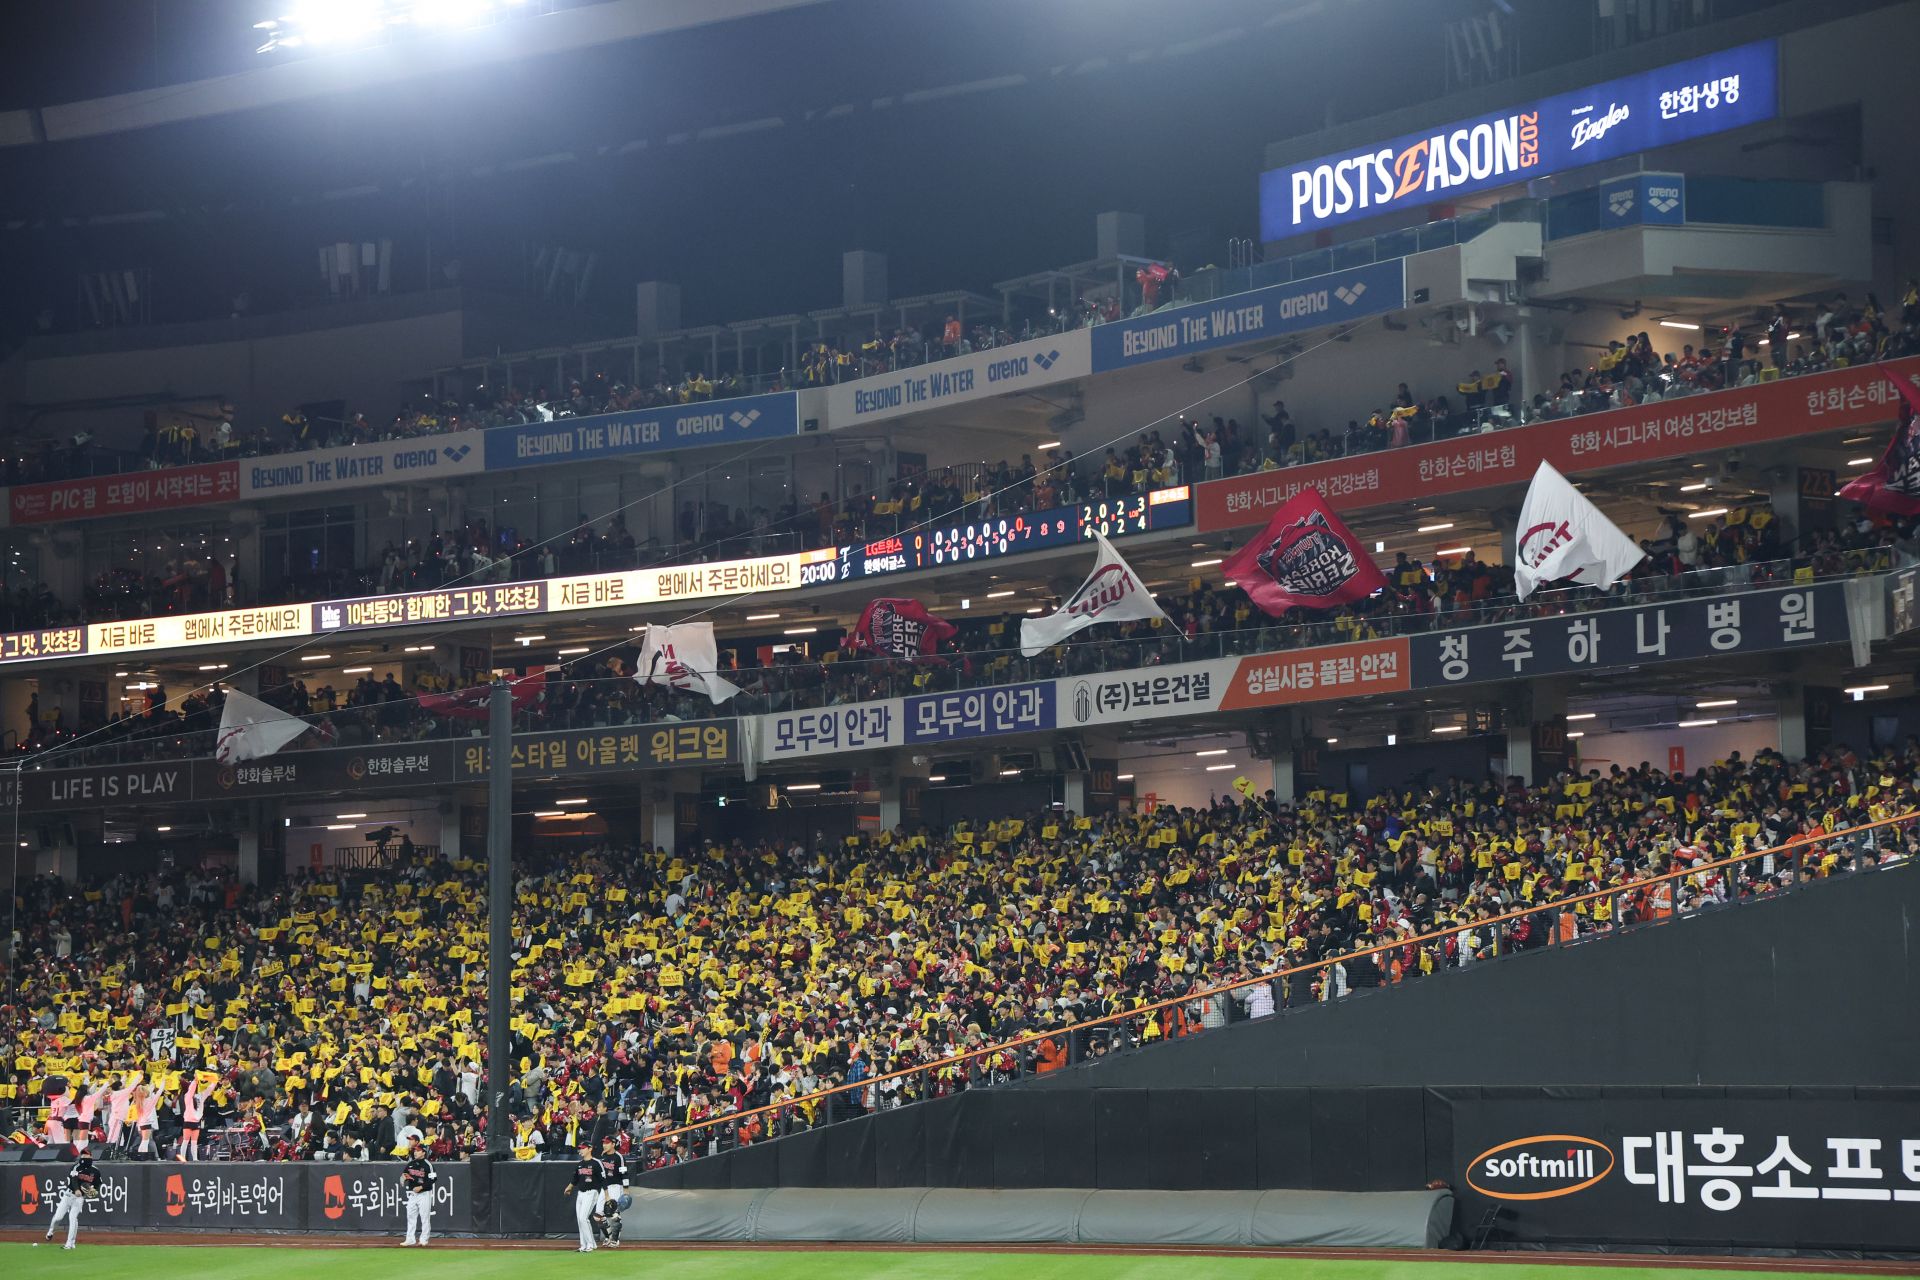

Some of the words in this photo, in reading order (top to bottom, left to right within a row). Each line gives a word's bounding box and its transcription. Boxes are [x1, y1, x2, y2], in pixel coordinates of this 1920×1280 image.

[1659, 75, 1740, 120] 한화생명
[1519, 111, 1539, 168] 2025
[1571, 102, 1629, 150] Eagles
[1291, 114, 1520, 225] POSTSEASON
[1609, 189, 1634, 203] arena
[1649, 187, 1678, 198] arena
[1123, 324, 1177, 357] BEYOND
[1181, 316, 1207, 344] THE
[1211, 305, 1263, 338] WATER
[1280, 290, 1328, 319] arena
[856, 385, 901, 414] BEYOND
[904, 378, 927, 404] THE
[930, 369, 974, 398] WATER
[988, 356, 1028, 382] arena
[517, 432, 573, 458] BEYOND
[577, 426, 603, 451] THE
[607, 421, 660, 447] WATER
[676, 414, 724, 436] arena
[1570, 432, 1601, 456] 한화
[1603, 421, 1661, 449] 시그니처
[1664, 415, 1694, 439] 여성
[1697, 402, 1758, 434] 건강보험
[252, 466, 303, 489] BEYOND
[307, 461, 331, 483] THE
[335, 456, 383, 479] WATER
[393, 449, 437, 470] arena
[1418, 444, 1517, 482] 한화손해보험
[106, 481, 150, 505] 모험이
[155, 474, 213, 499] 시작되는
[1226, 490, 1252, 513] 한화
[1330, 468, 1379, 497] 건강보험
[864, 555, 906, 574] 한화이글스
[916, 553, 921, 566] 1
[936, 549, 943, 564] 0
[952, 546, 959, 561] 0
[967, 543, 975, 558] 0
[985, 541, 990, 555] 1
[999, 538, 1007, 553] 0
[1100, 521, 1109, 536] 0
[1117, 518, 1125, 534] 2
[1137, 515, 1146, 530] 4
[865, 537, 903, 556] LG트윈스
[915, 535, 922, 549] 0
[935, 531, 943, 545] 0
[951, 528, 959, 543] 0
[967, 525, 974, 540] 0
[983, 523, 990, 537] 0
[999, 520, 1006, 535] 0
[1015, 517, 1023, 532] 0
[1084, 506, 1092, 521] 2
[1099, 503, 1107, 519] 0
[1117, 500, 1125, 515] 2
[1137, 497, 1145, 512] 3
[945, 539, 952, 553] 2
[961, 536, 967, 549] 3
[976, 534, 983, 547] 4
[992, 531, 999, 544] 5
[1008, 528, 1015, 542] 6
[1024, 526, 1032, 539] 7
[1041, 523, 1048, 536] 8
[1057, 520, 1065, 533] 9
[347, 599, 402, 625] 10년동안
[407, 594, 450, 620] 함께한
[454, 593, 468, 615] 그
[494, 585, 539, 611] 맛초킹
[561, 582, 590, 605] 지금
[595, 579, 624, 603] 바로
[658, 570, 703, 596] 앱에서
[708, 561, 791, 591] 주문하세요!
[801, 561, 836, 584] 20:00
[41, 629, 81, 654] 맛초킹
[100, 626, 125, 648] 지금
[129, 623, 155, 645] 바로
[184, 616, 224, 640] 앱에서
[228, 608, 300, 639] 주문하세요!
[917, 693, 986, 736] 모두의
[993, 687, 1044, 731] 안과
[1096, 671, 1211, 714] (주)보은건설
[465, 740, 568, 774] 워스타일
[577, 734, 639, 766] 아울렛
[650, 726, 728, 763] 워크업
[775, 711, 839, 752] 모두의
[845, 705, 892, 746] 안과
[52, 777, 93, 801] LIFE
[101, 775, 119, 797] IS
[127, 771, 178, 795] PLAY
[237, 765, 296, 785] 한화솔루션
[367, 755, 430, 775] 한화솔루션
[1485, 1149, 1594, 1179] softmill
[187, 1176, 283, 1216] 육회바른연어
